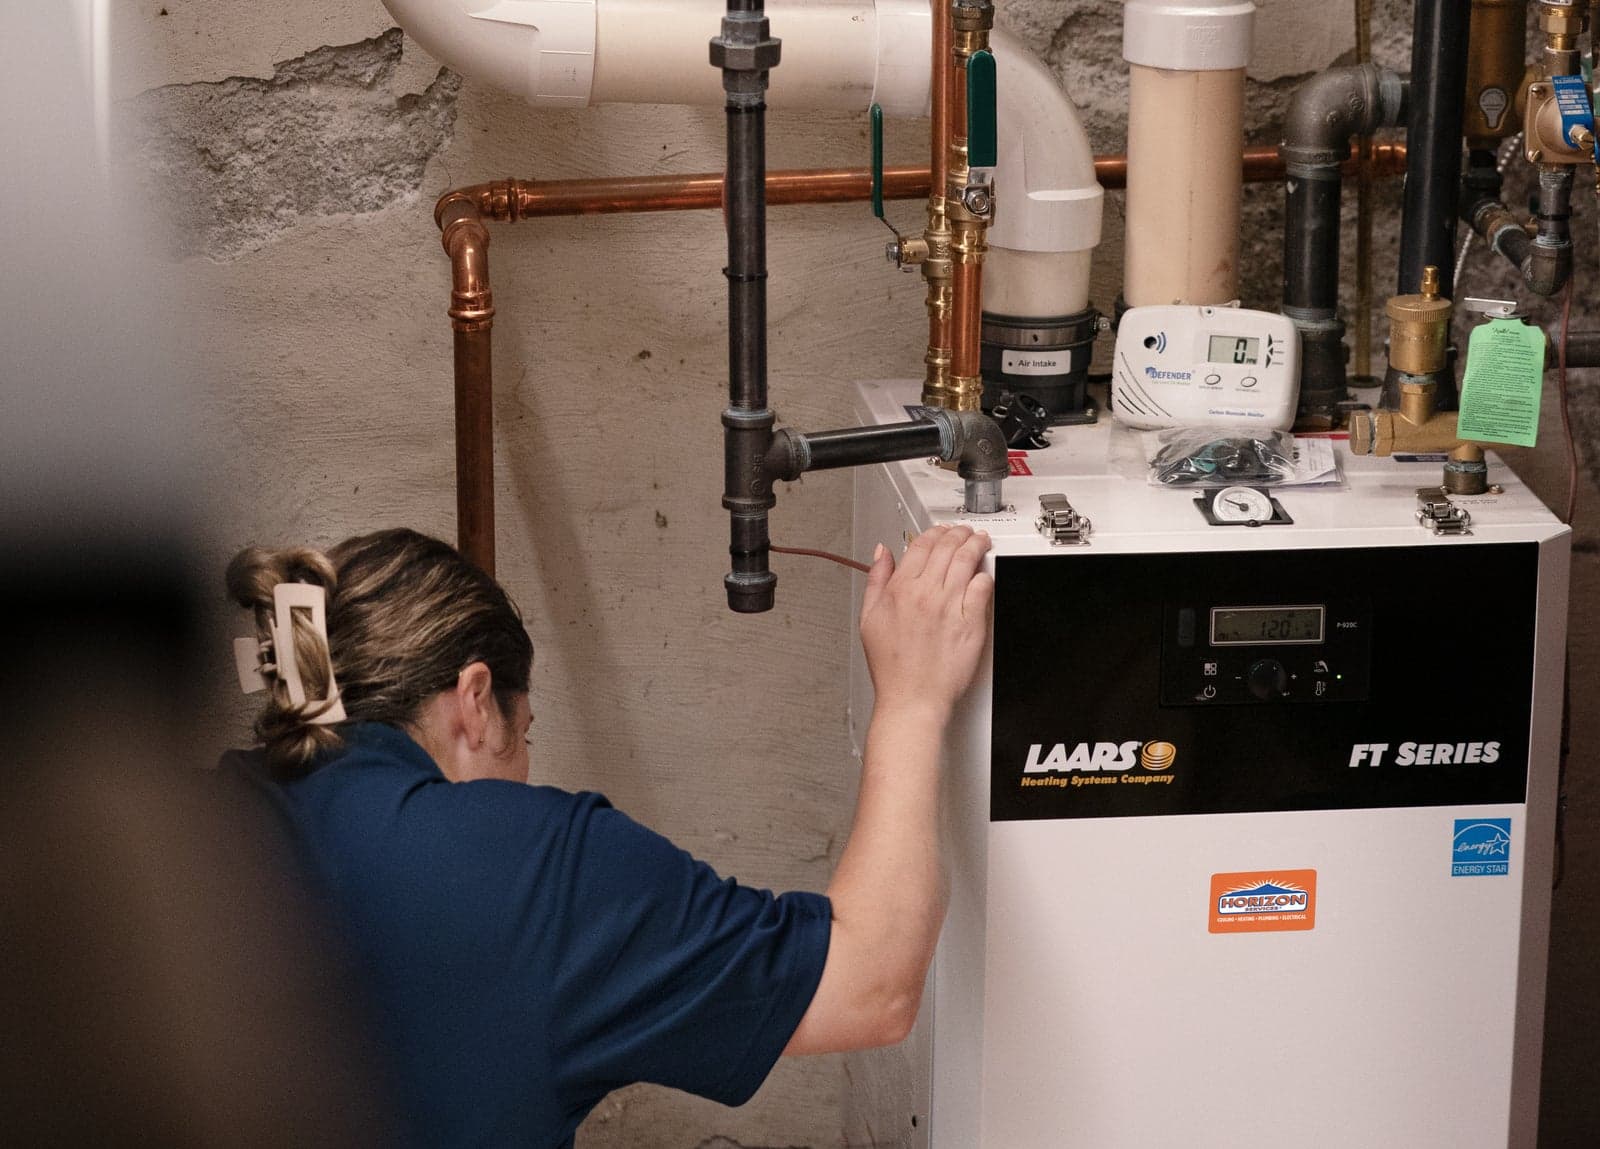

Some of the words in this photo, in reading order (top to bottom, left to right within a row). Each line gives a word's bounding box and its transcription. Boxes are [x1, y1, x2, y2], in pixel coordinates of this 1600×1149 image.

[1233, 338, 1248, 365] 0
[1018, 360, 1030, 368] Air
[1032, 360, 1057, 368] Intake
[1152, 370, 1192, 380] DEFENDER
[1024, 741, 1138, 773] LAARS
[1348, 743, 1389, 767] FT
[1395, 741, 1501, 766] SERIES
[1021, 776, 1068, 787] Heating
[1070, 775, 1118, 787] Systems
[1121, 774, 1175, 785] Company
[1453, 864, 1485, 874] ENERGY
[1486, 864, 1507, 873] STAR
[1221, 895, 1306, 909] HORIZON
